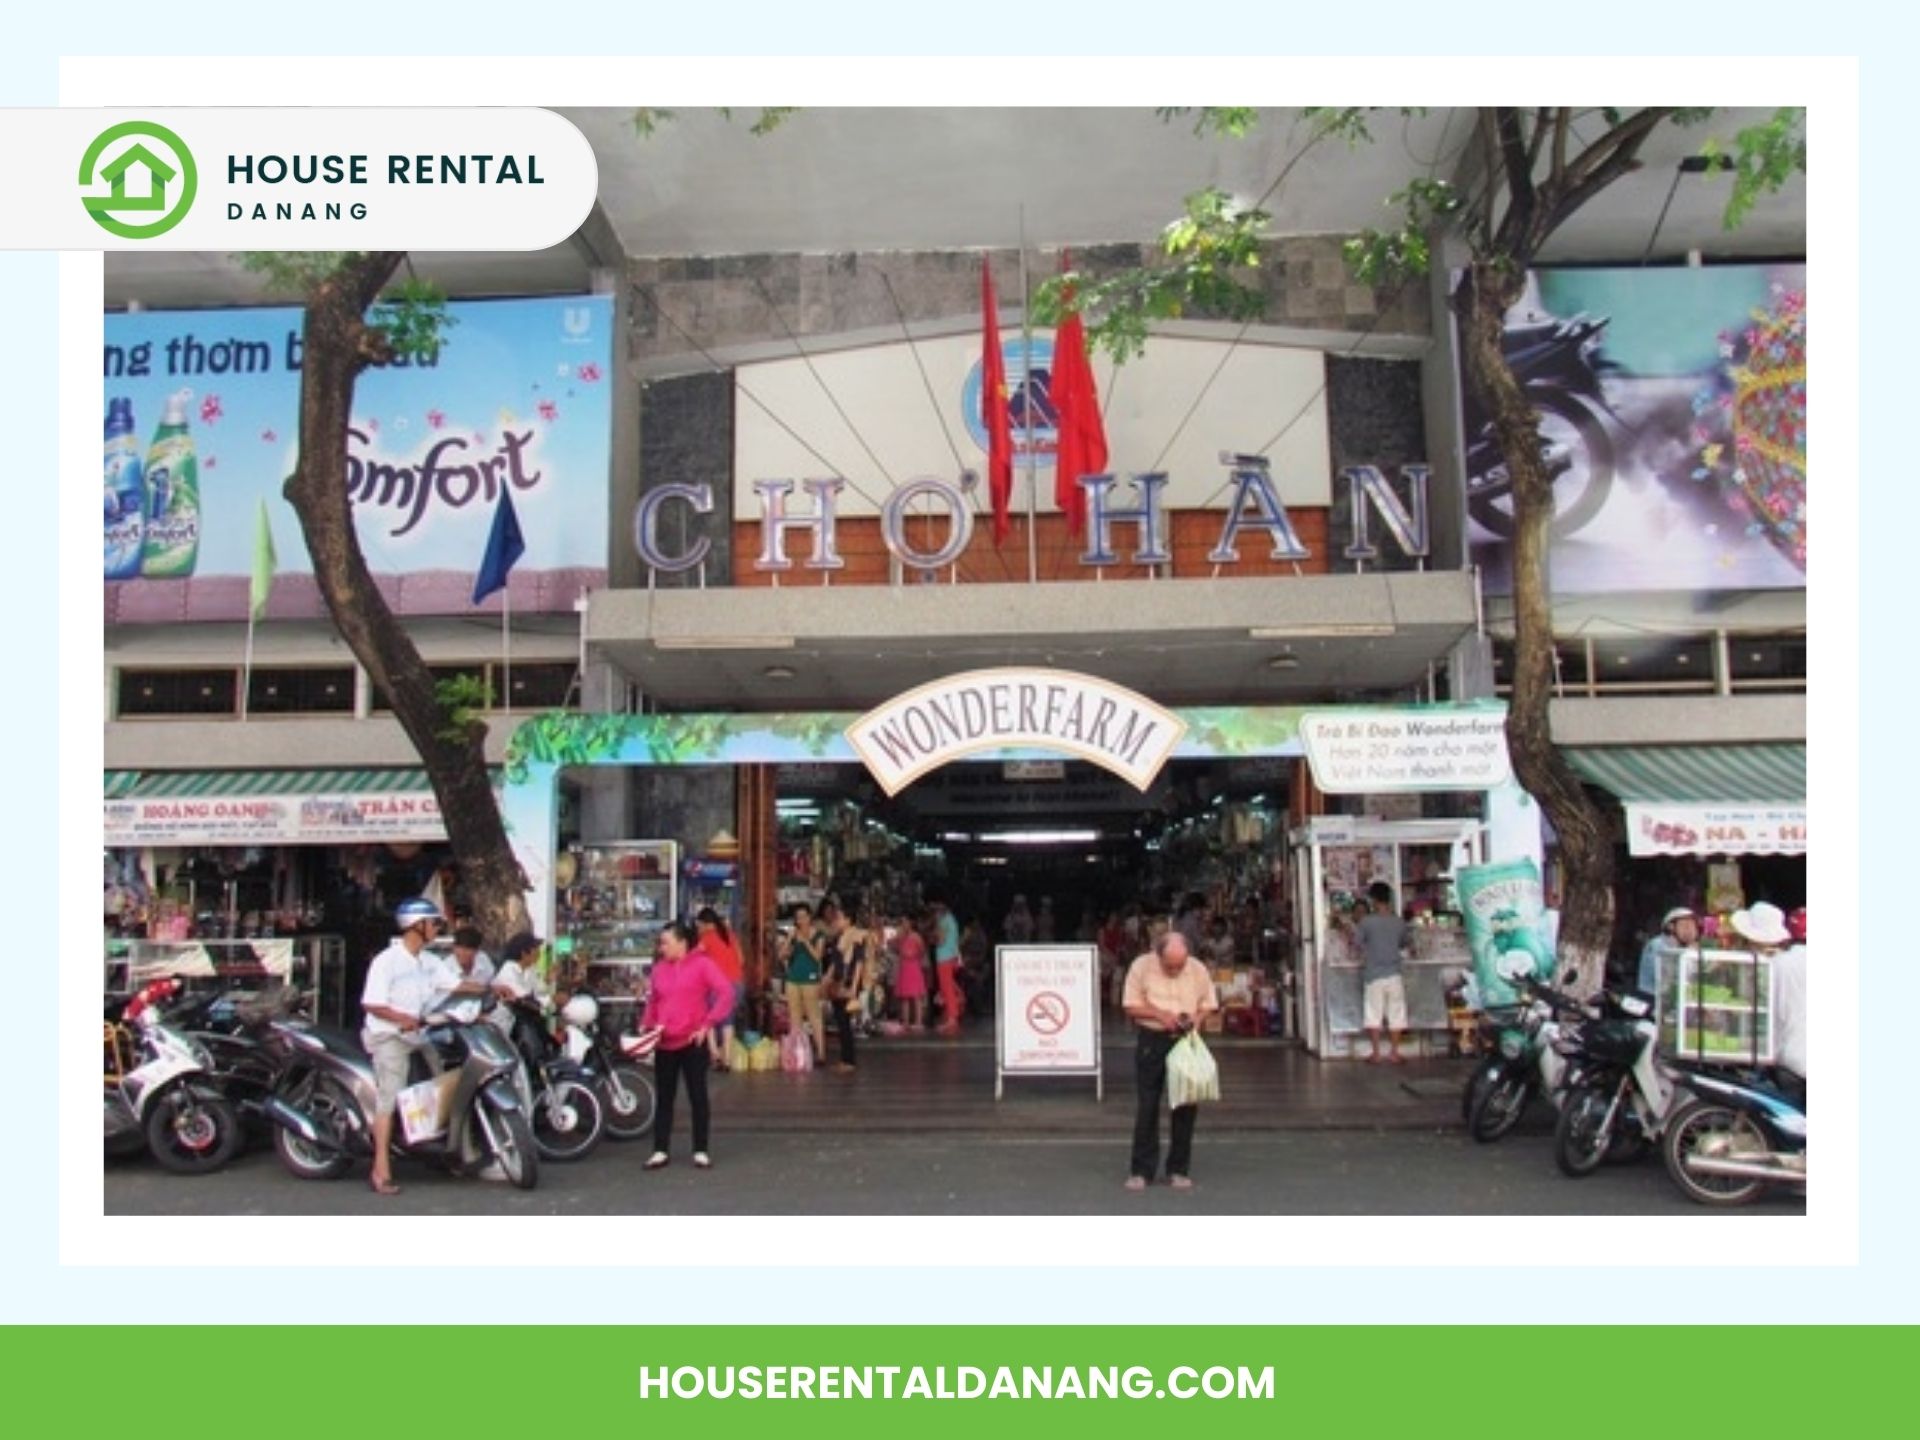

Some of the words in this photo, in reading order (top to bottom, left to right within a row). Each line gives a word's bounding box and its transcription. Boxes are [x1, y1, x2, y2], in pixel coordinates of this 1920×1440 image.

[166, 333, 272, 375] thơm
[1078, 451, 1434, 565] HÀN
[868, 683, 1158, 771] WONDERFARM
[1431, 739, 1462, 757] cho
[1778, 825, 1806, 841] H
